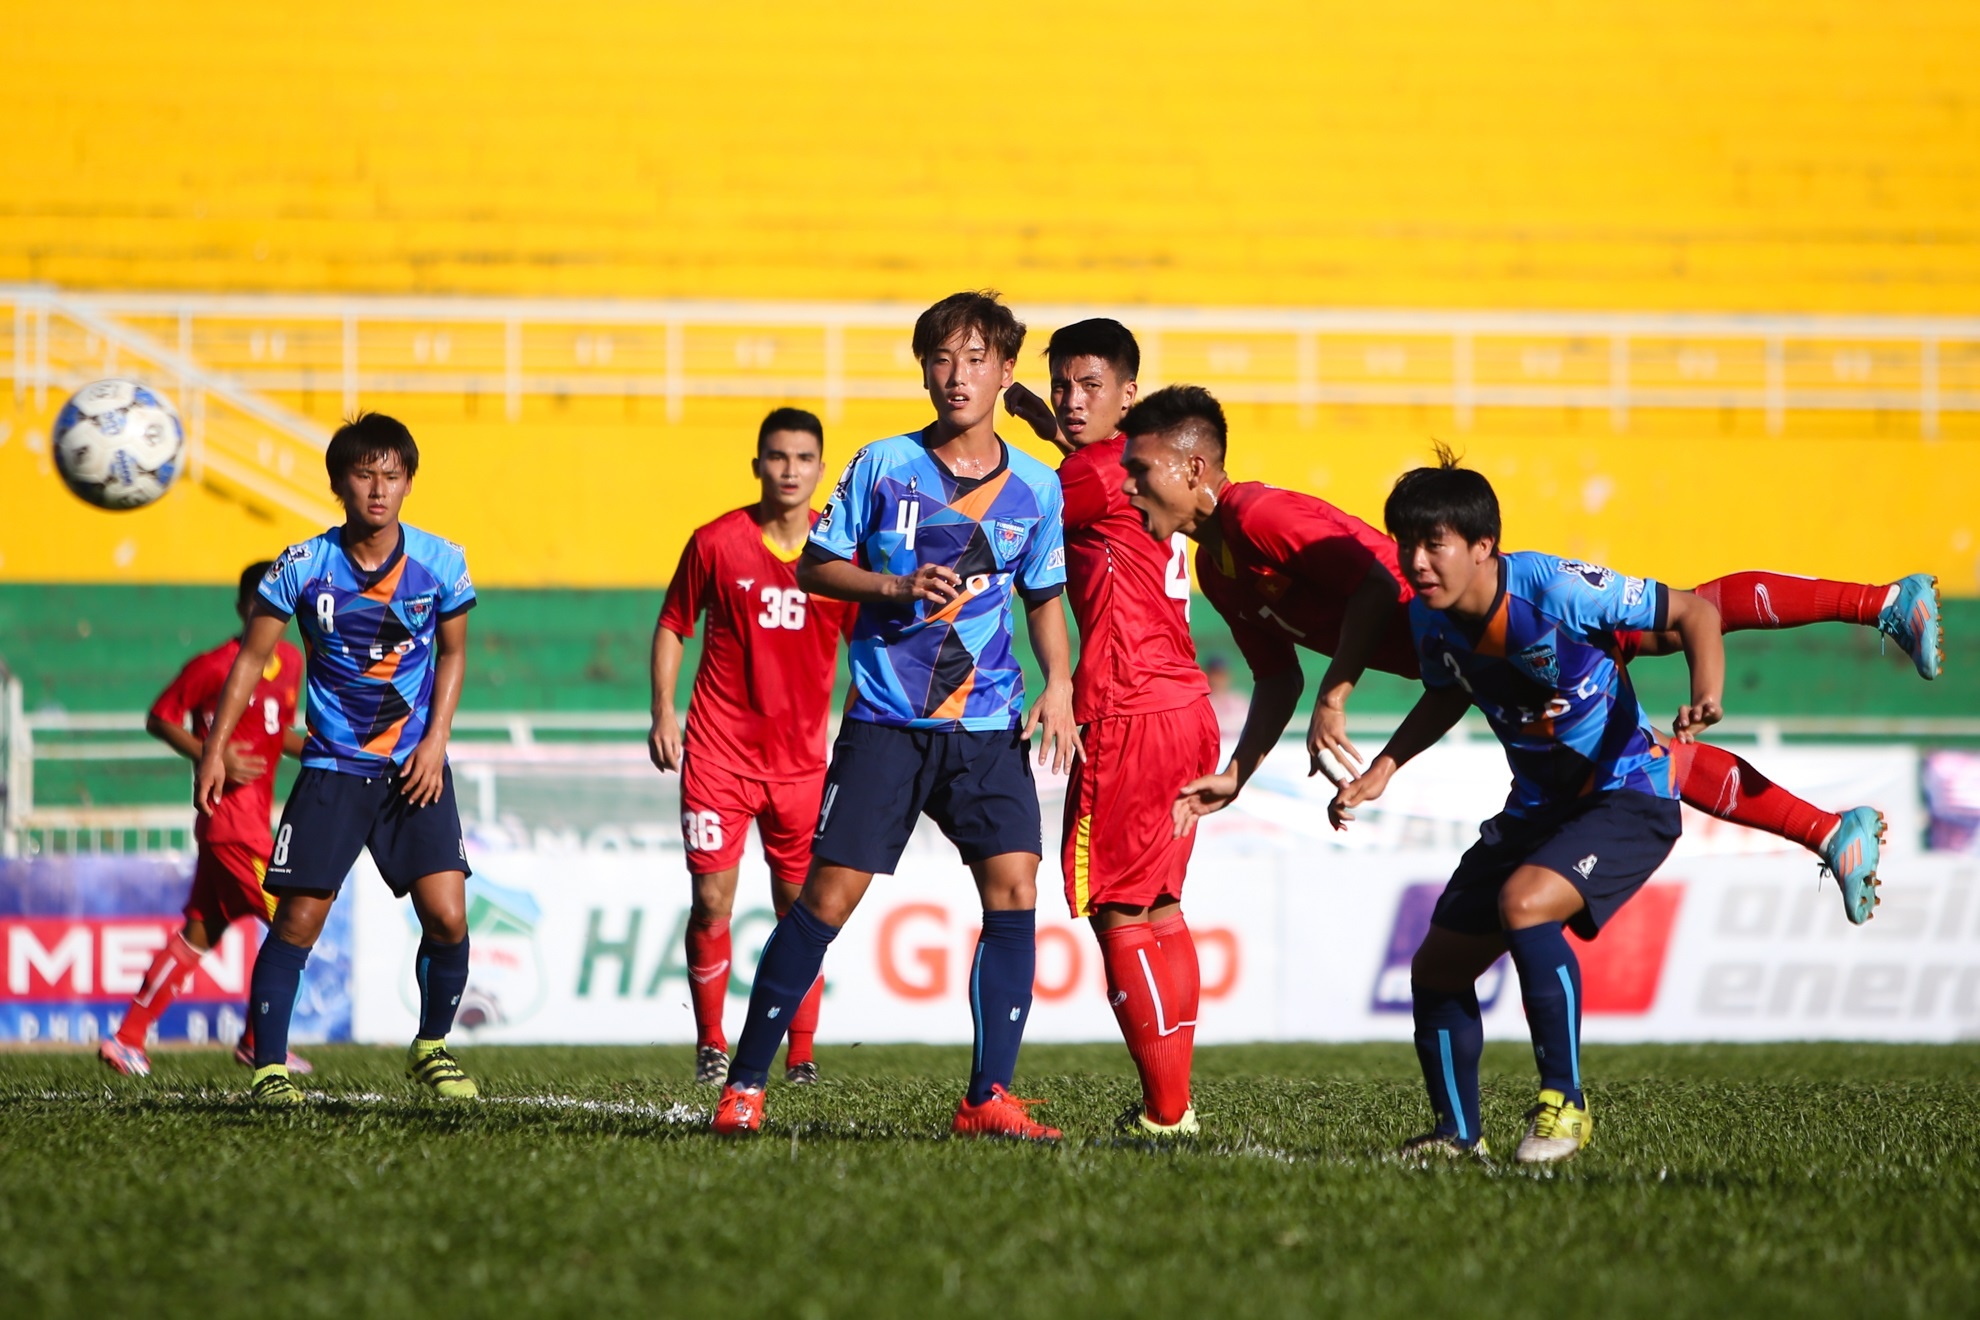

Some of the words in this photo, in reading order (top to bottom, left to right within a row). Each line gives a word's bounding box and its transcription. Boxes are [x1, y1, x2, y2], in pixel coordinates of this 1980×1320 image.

[896, 499, 919, 551] 4
[316, 593, 335, 634] 8
[758, 587, 807, 631] 36
[682, 811, 724, 851] 36
[819, 782, 840, 833] 4
[273, 823, 293, 867] 8
[1712, 867, 1980, 939] onsi
[8, 925, 245, 995] MEN
[575, 907, 834, 997] HAG
